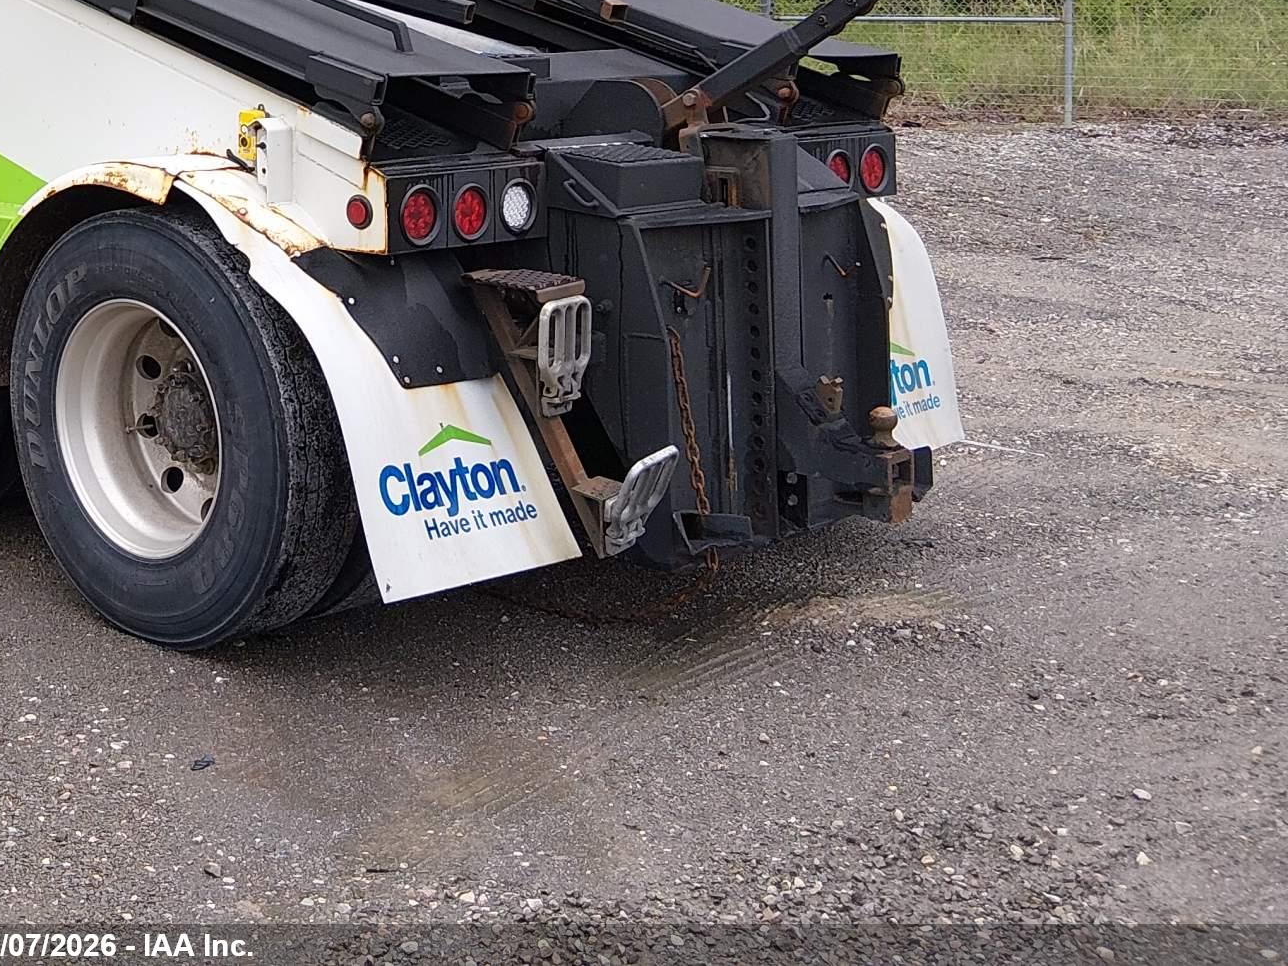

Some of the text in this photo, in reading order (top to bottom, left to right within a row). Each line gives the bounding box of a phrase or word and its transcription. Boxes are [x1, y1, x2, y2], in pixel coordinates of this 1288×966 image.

[24, 263, 88, 474] DUNLOP
[912, 393, 941, 416] made
[379, 456, 521, 517] Clayton
[424, 500, 538, 541] Have it made
